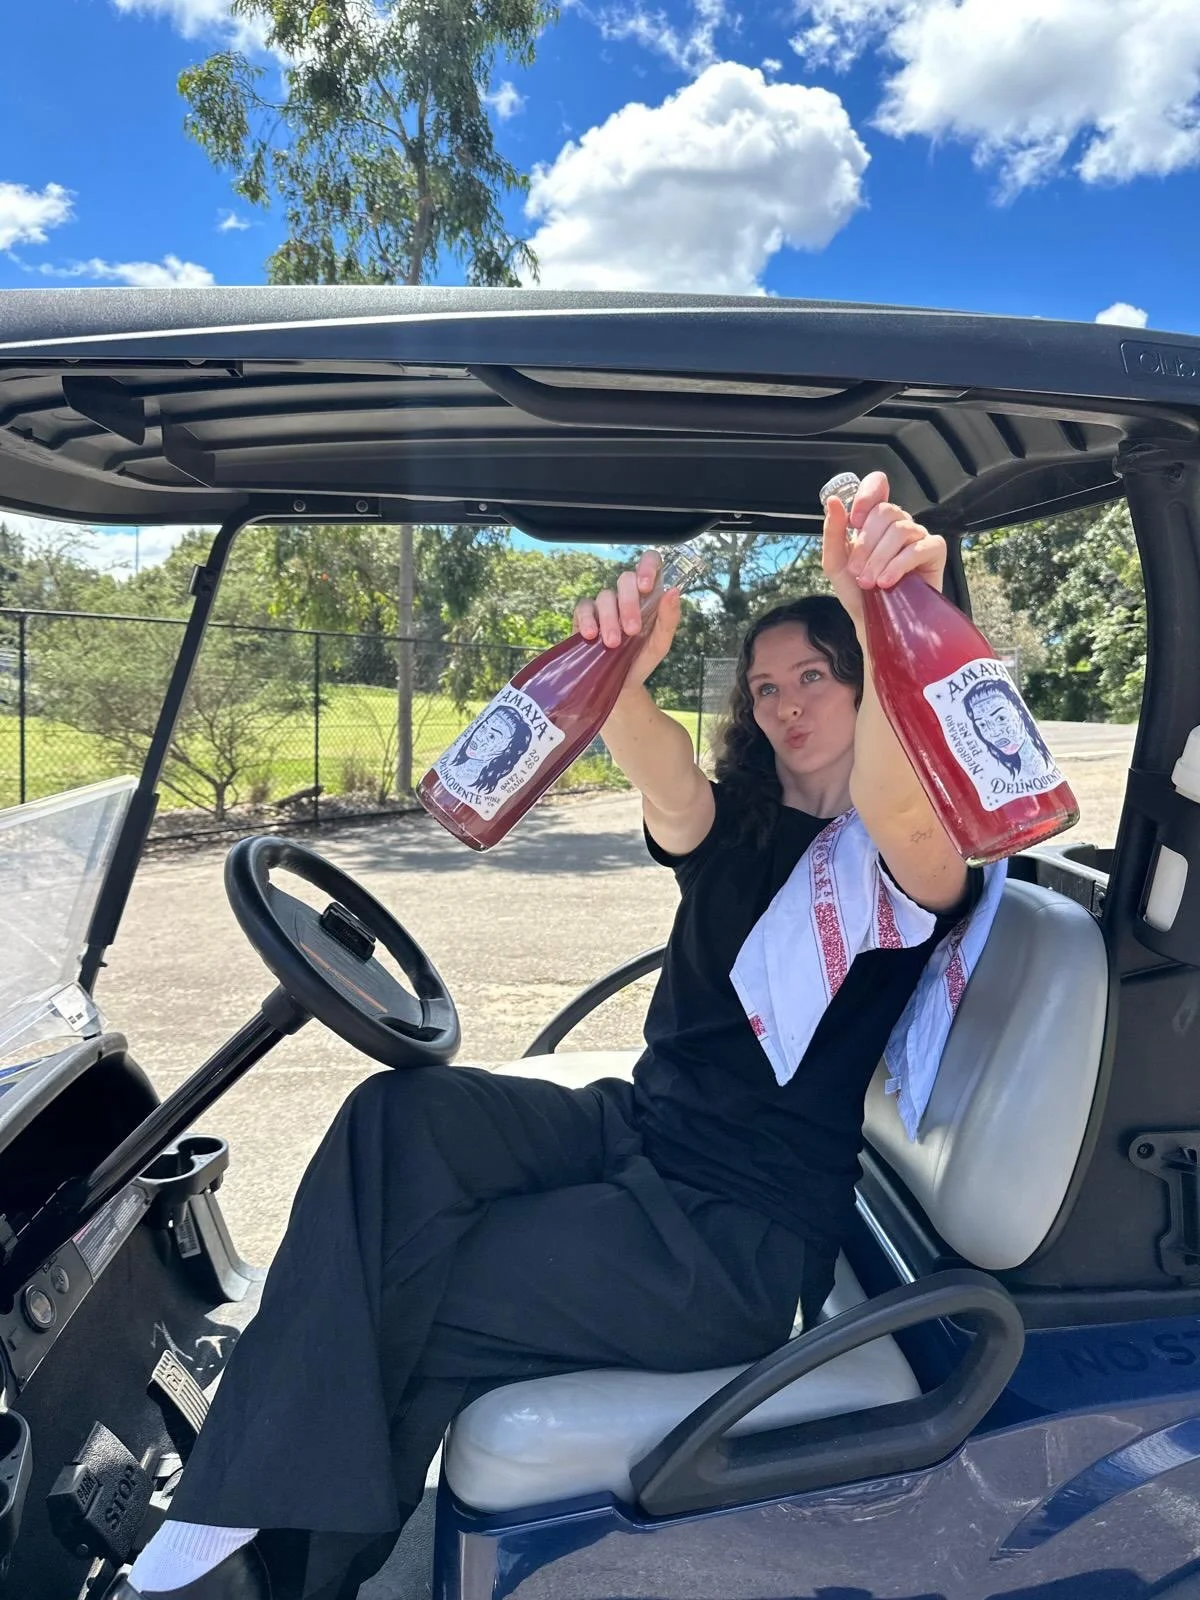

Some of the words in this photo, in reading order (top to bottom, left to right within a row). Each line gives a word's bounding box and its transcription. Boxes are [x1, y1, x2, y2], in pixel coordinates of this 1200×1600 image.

[497, 690, 549, 741] AMAYA
[944, 714, 984, 775] NEGROAMARO
[1059, 1341, 1149, 1377] NO
[105, 1464, 136, 1530] STOP
